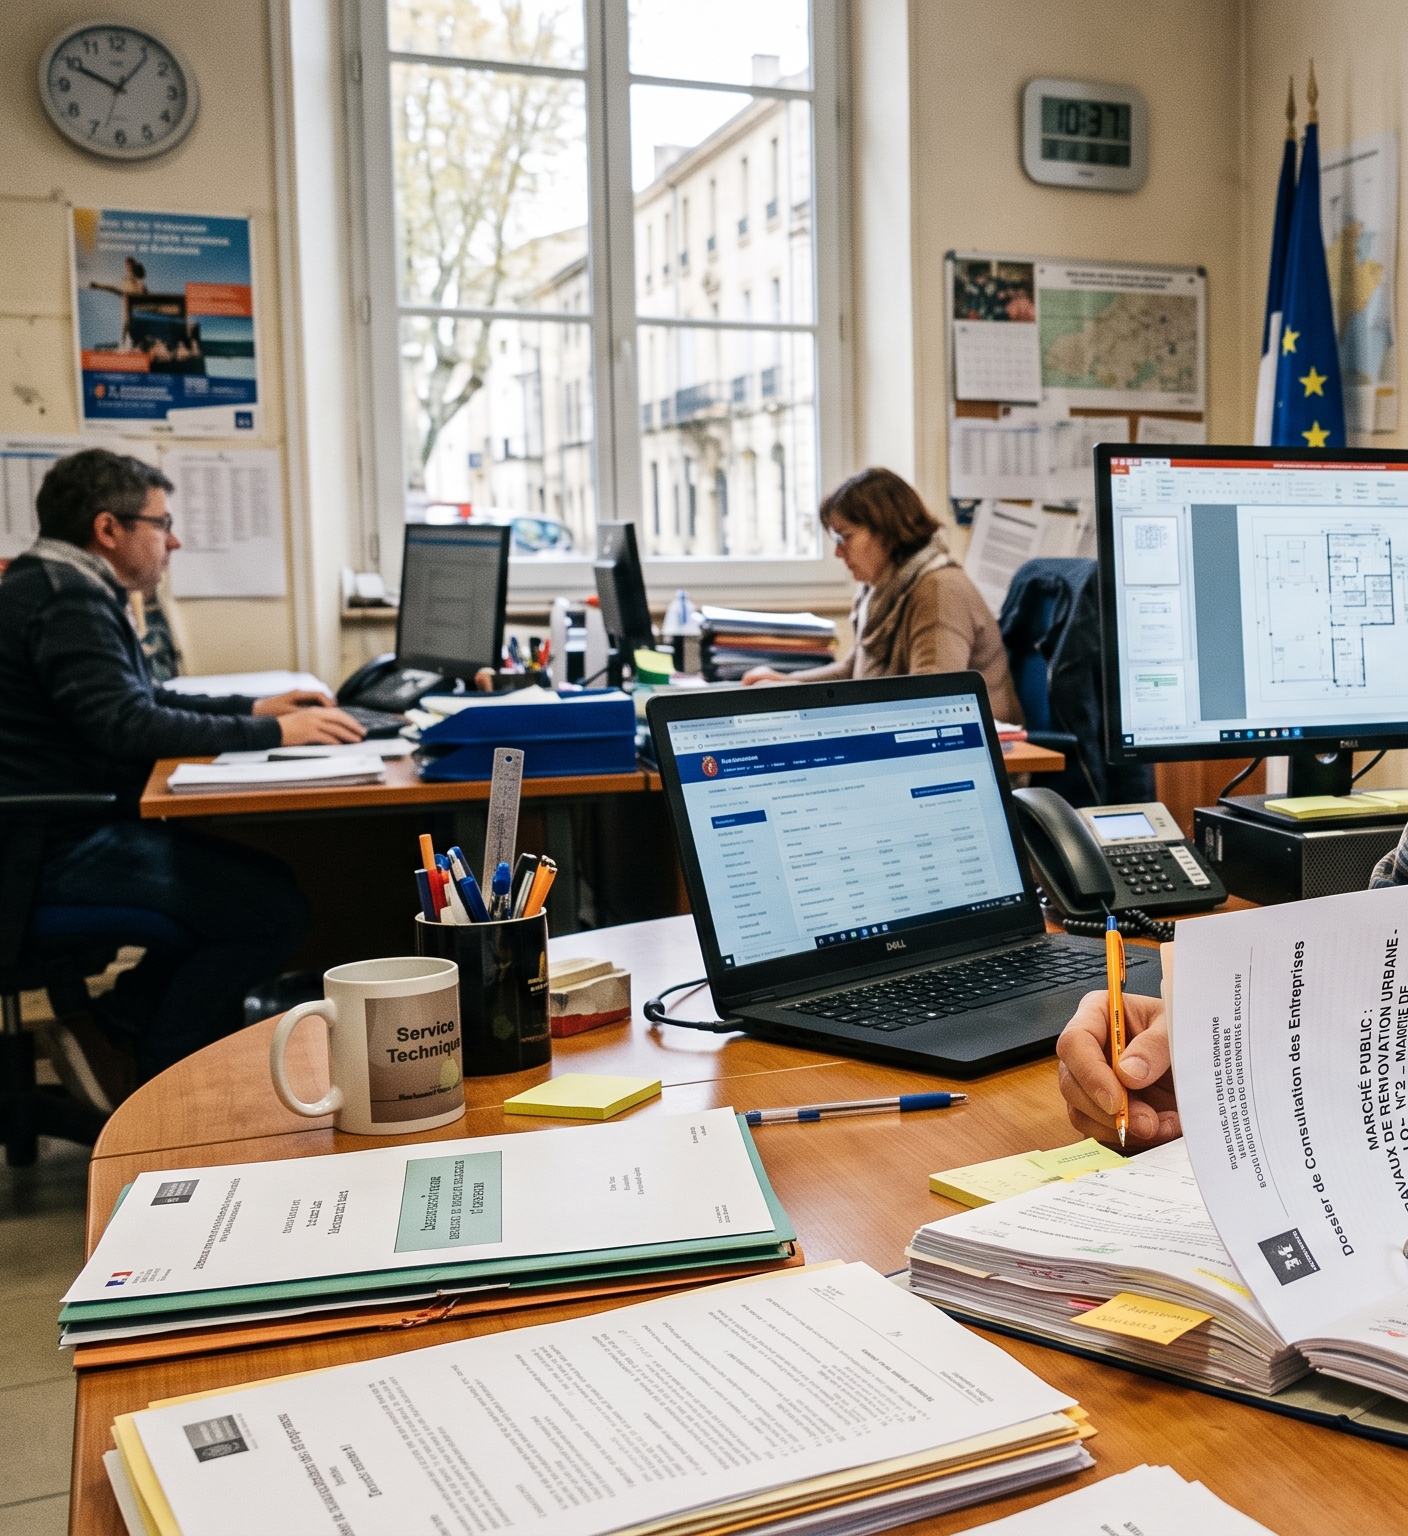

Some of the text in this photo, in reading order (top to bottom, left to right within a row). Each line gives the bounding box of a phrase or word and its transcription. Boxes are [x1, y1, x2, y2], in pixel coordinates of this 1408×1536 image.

[83, 40, 98, 55] 11
[109, 36, 126, 52] 12
[1381, 937, 1398, 1002] URBANE
[1289, 940, 1305, 1030] Entreprises
[397, 1021, 454, 1042] Service
[1289, 1034, 1300, 1062] des
[1357, 1079, 1379, 1150] MARCHÉ
[1382, 1120, 1395, 1142] DE
[1312, 1173, 1325, 1193] de
[1321, 1197, 1355, 1256] Dossier
